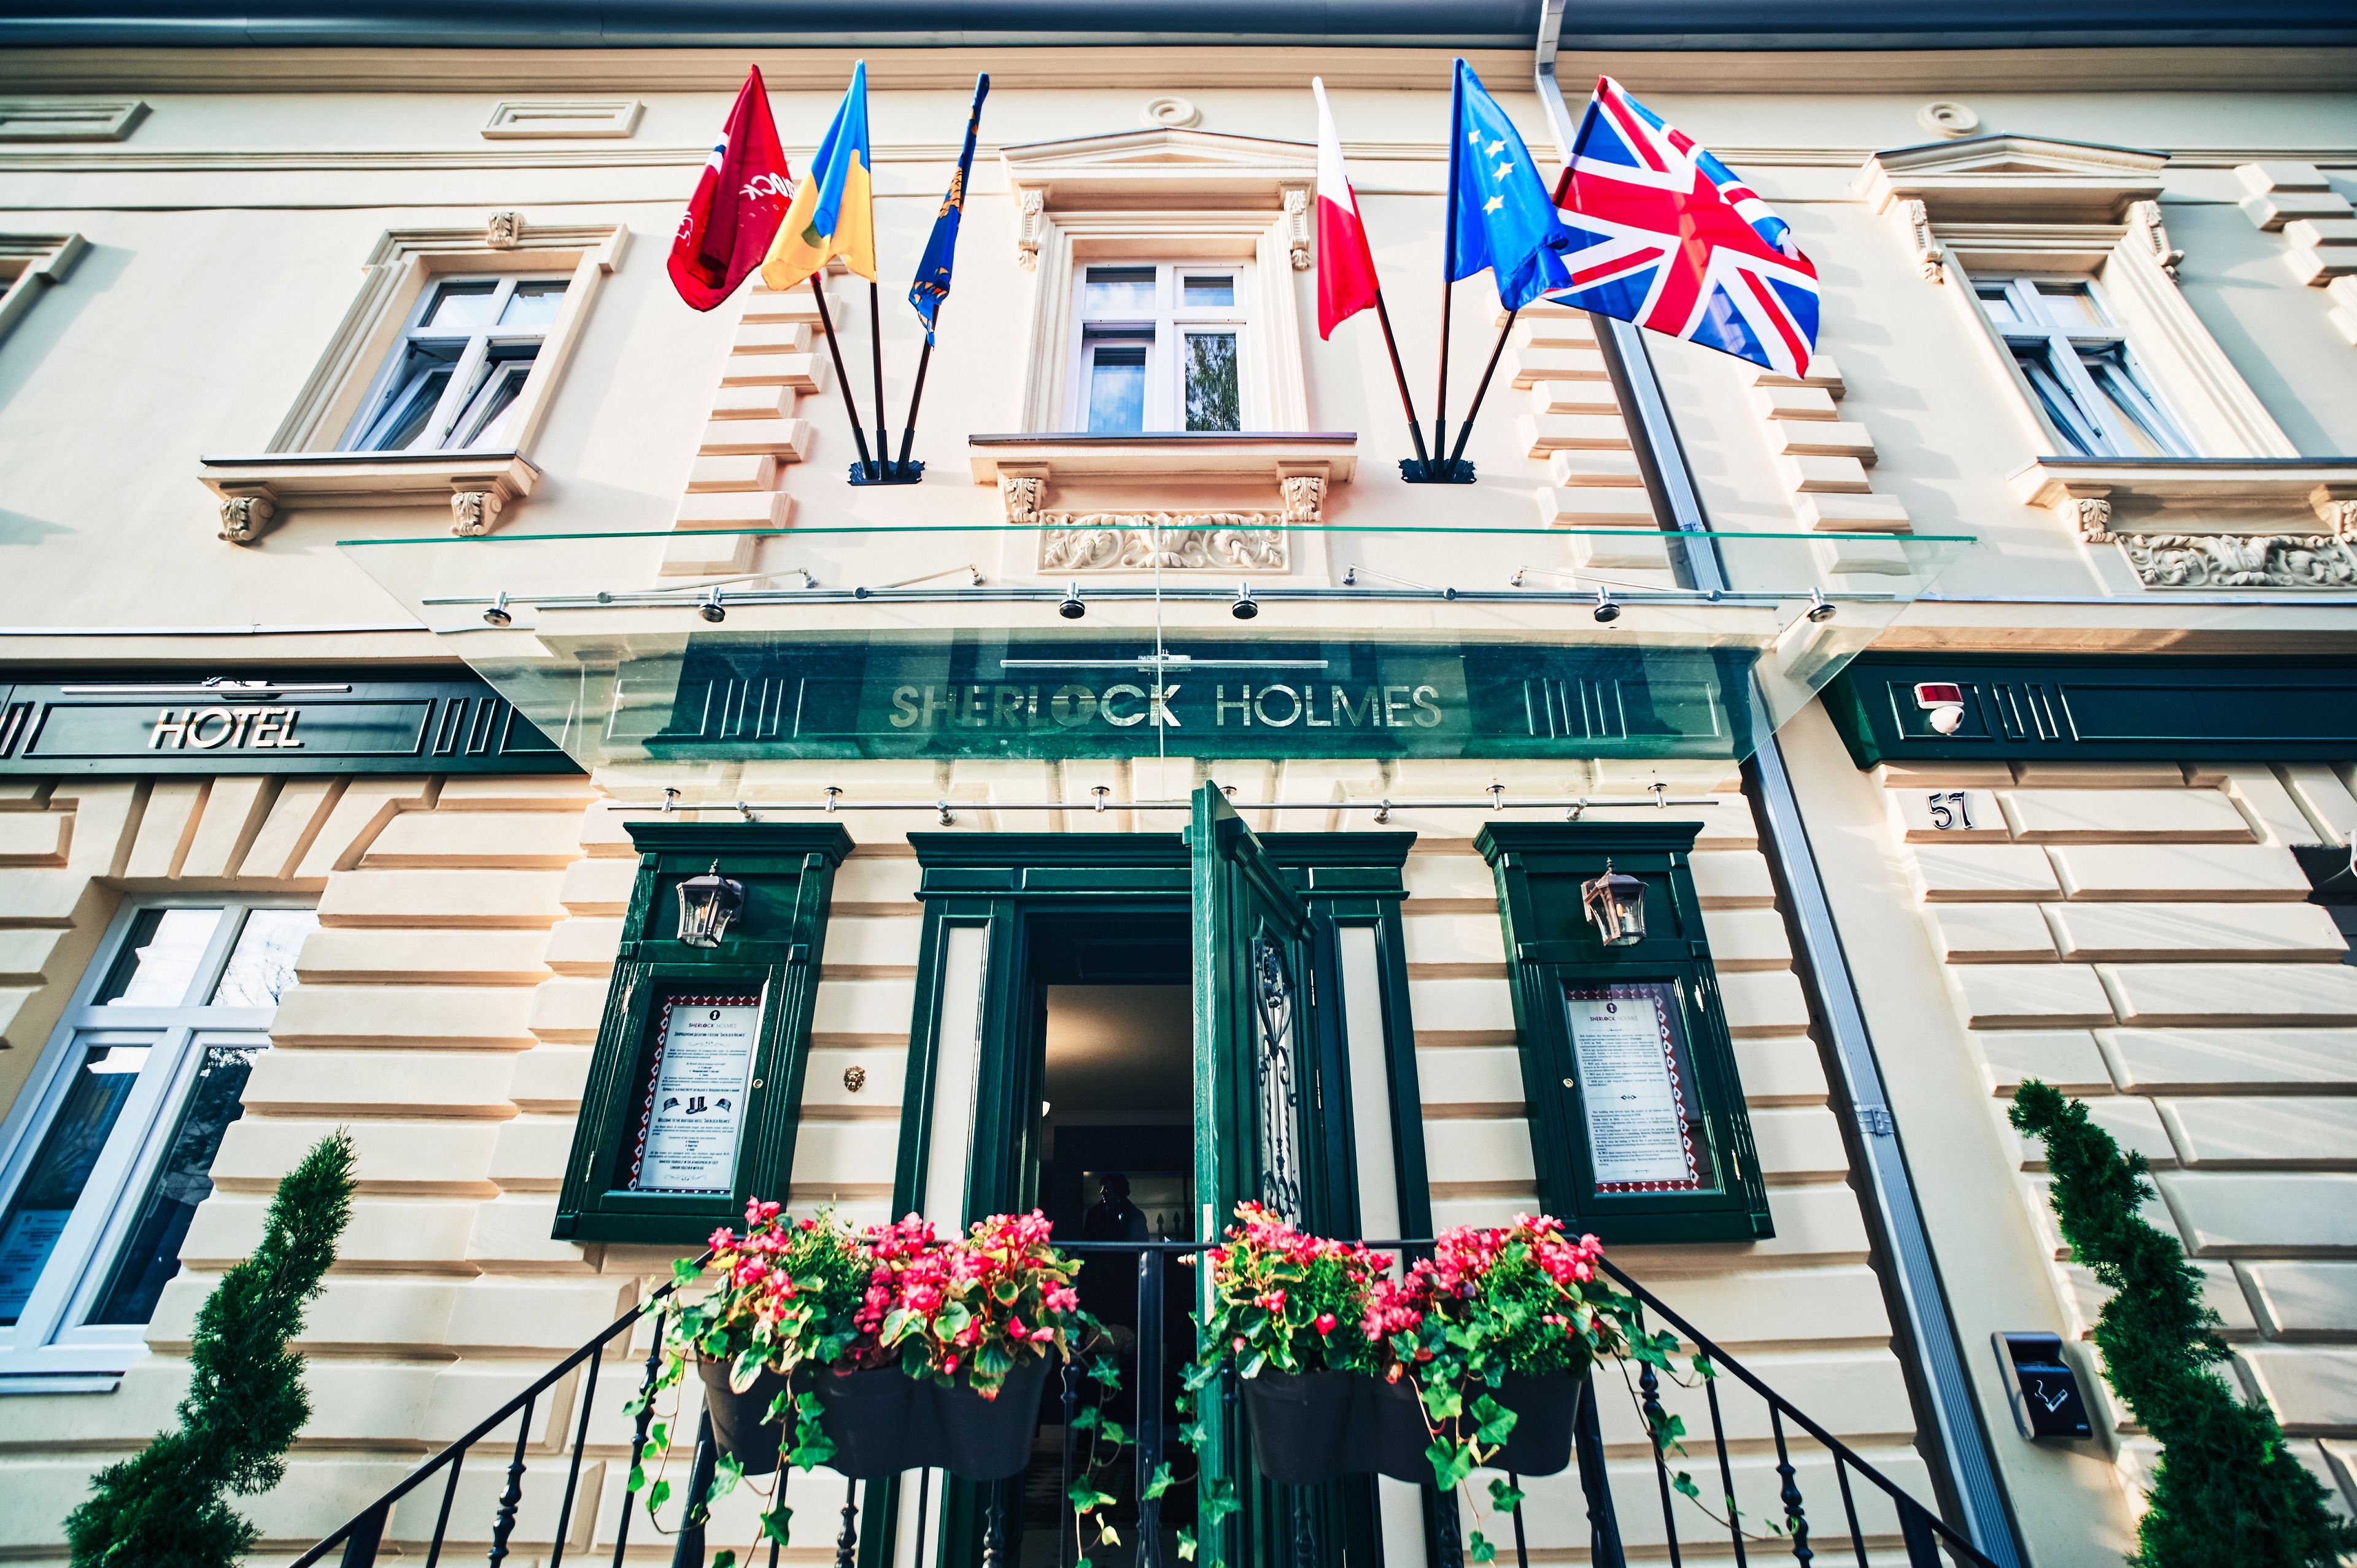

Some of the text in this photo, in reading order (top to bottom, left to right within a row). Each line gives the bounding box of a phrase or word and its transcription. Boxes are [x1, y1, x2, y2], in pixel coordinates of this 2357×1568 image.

[889, 684, 1442, 728] SHERLOCK HOLMES
[148, 707, 302, 749] HOTEL
[1927, 792, 1973, 829] 57
